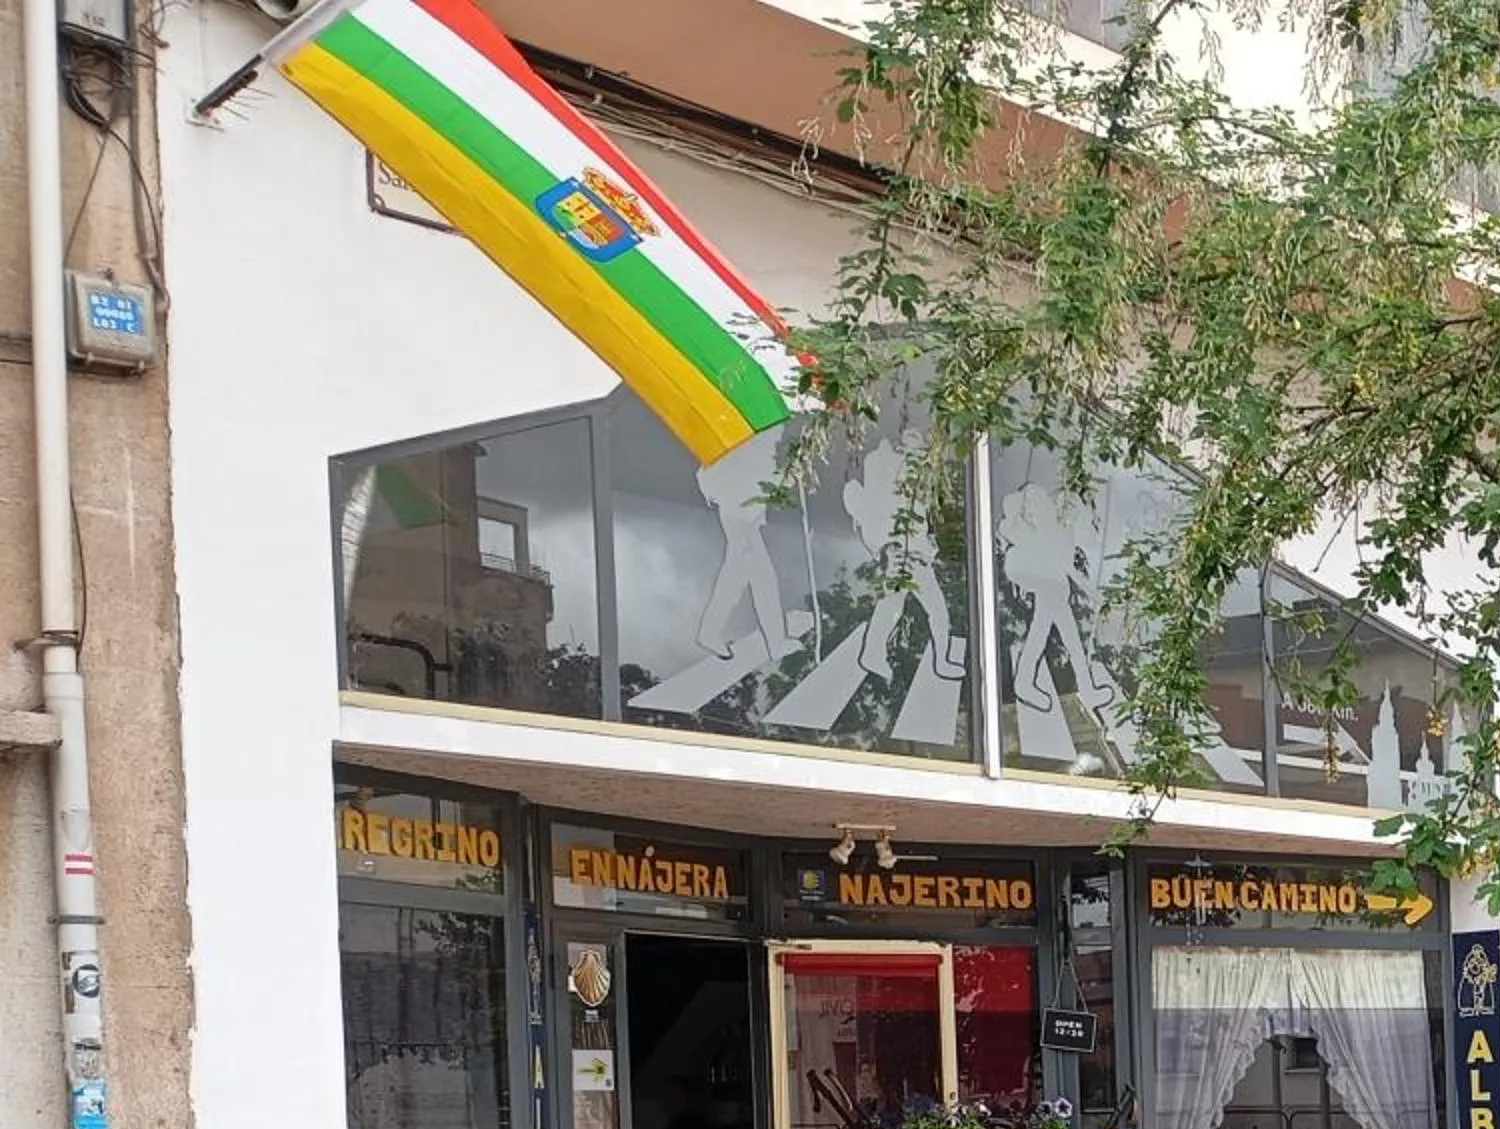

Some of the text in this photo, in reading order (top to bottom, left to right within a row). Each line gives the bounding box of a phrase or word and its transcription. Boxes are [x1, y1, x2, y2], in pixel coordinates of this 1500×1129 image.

[339, 806, 500, 867] REGRINO
[571, 846, 616, 887] EN
[838, 872, 1033, 910] NAJERINO
[1150, 876, 1358, 914] BUEN CAMINO
